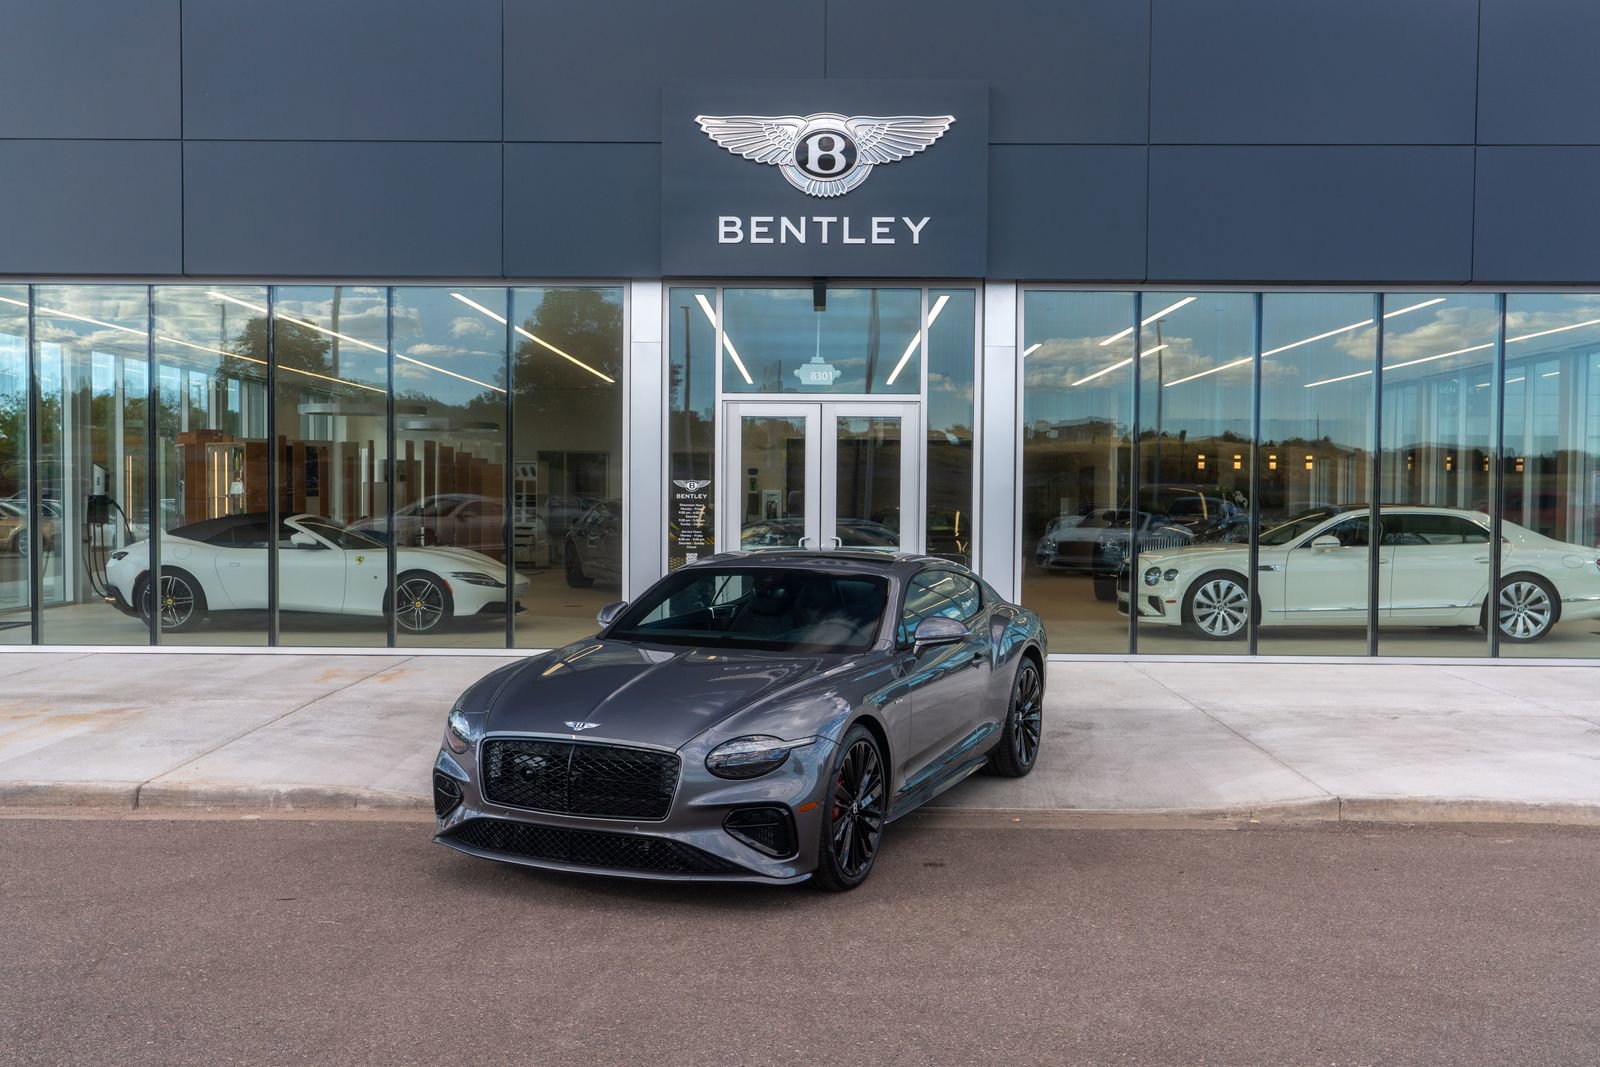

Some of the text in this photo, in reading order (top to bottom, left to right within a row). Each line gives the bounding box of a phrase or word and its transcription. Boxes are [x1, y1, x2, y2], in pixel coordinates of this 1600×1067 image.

[806, 133, 847, 175] B
[718, 215, 931, 244] BENTLEY
[810, 371, 833, 381] 8301
